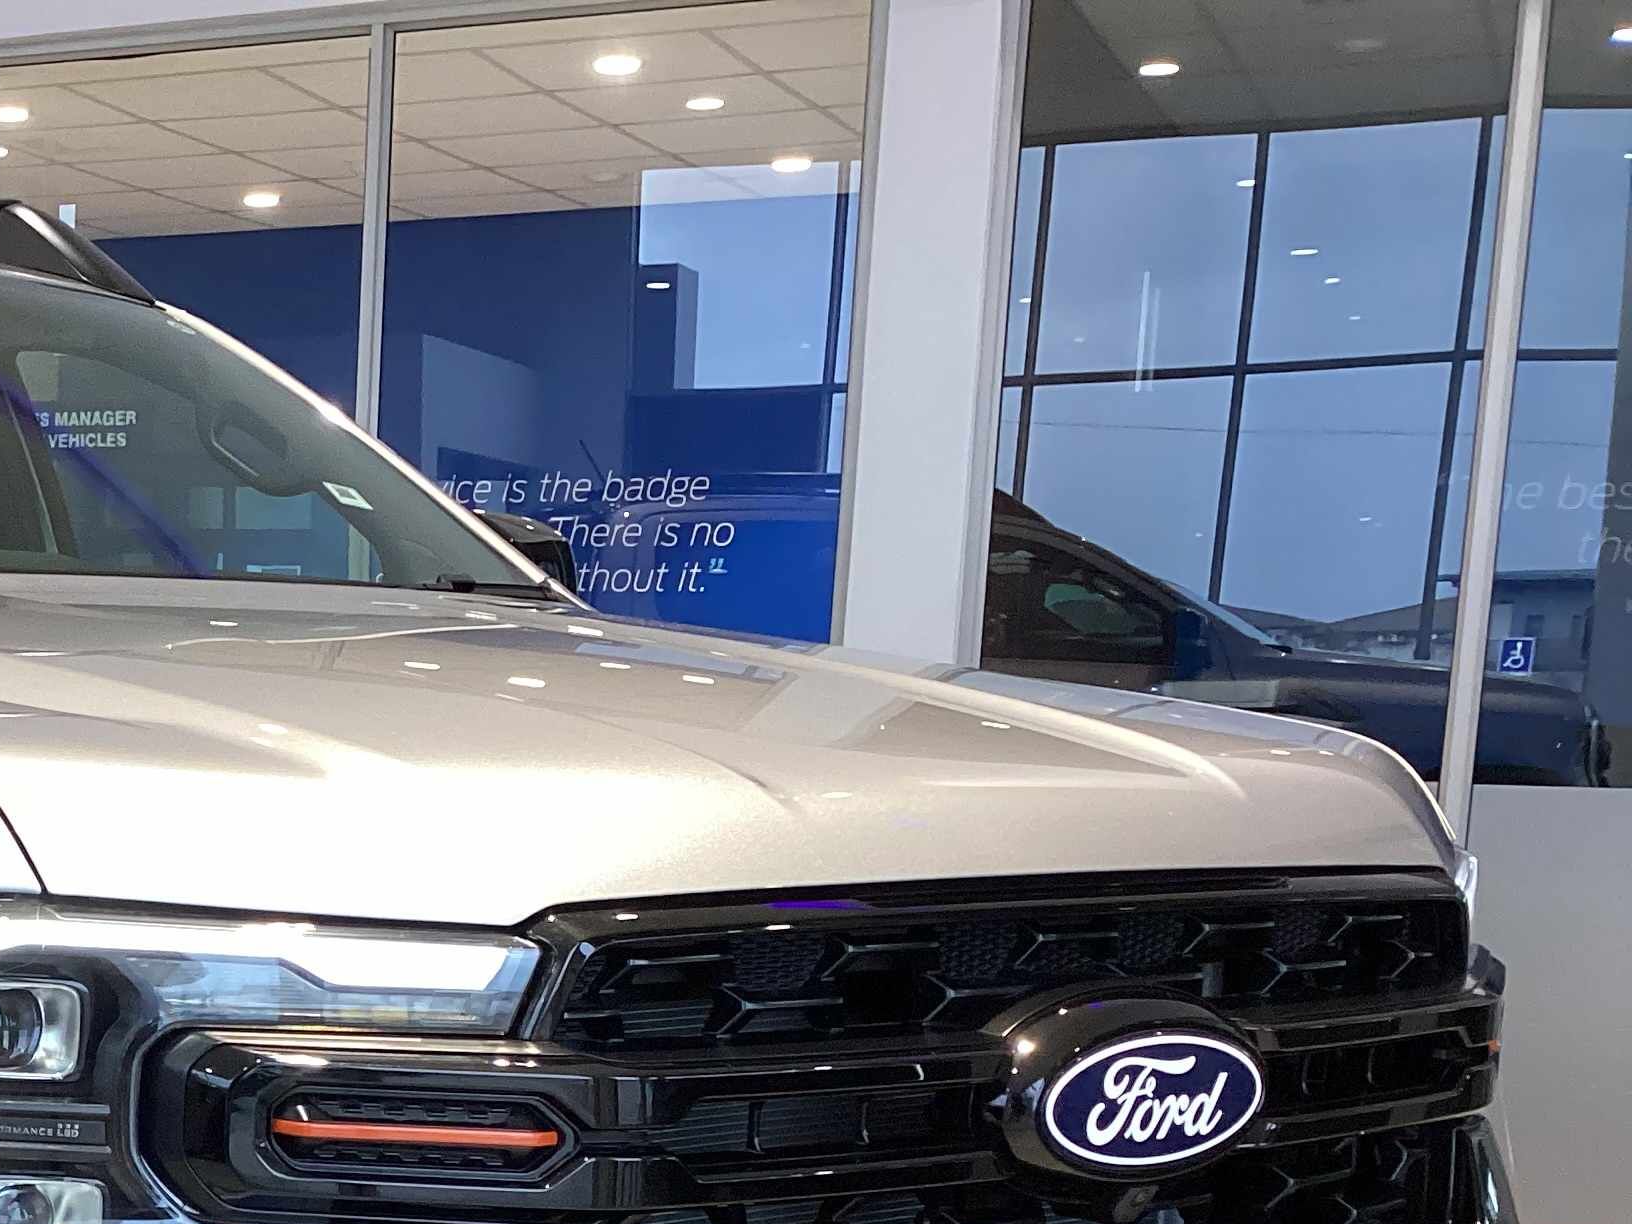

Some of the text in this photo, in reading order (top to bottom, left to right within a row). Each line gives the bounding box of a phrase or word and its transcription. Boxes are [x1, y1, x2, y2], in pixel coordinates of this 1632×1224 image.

[54, 410, 137, 427] MANAGER
[48, 432, 127, 449] VEHICLES
[502, 472, 528, 503] is
[538, 470, 593, 503] the
[602, 468, 710, 508] badge
[549, 515, 735, 548] There is no
[574, 560, 669, 593] thout
[1086, 1055, 1229, 1146] Ford
[56, 1123, 80, 1138] LED
